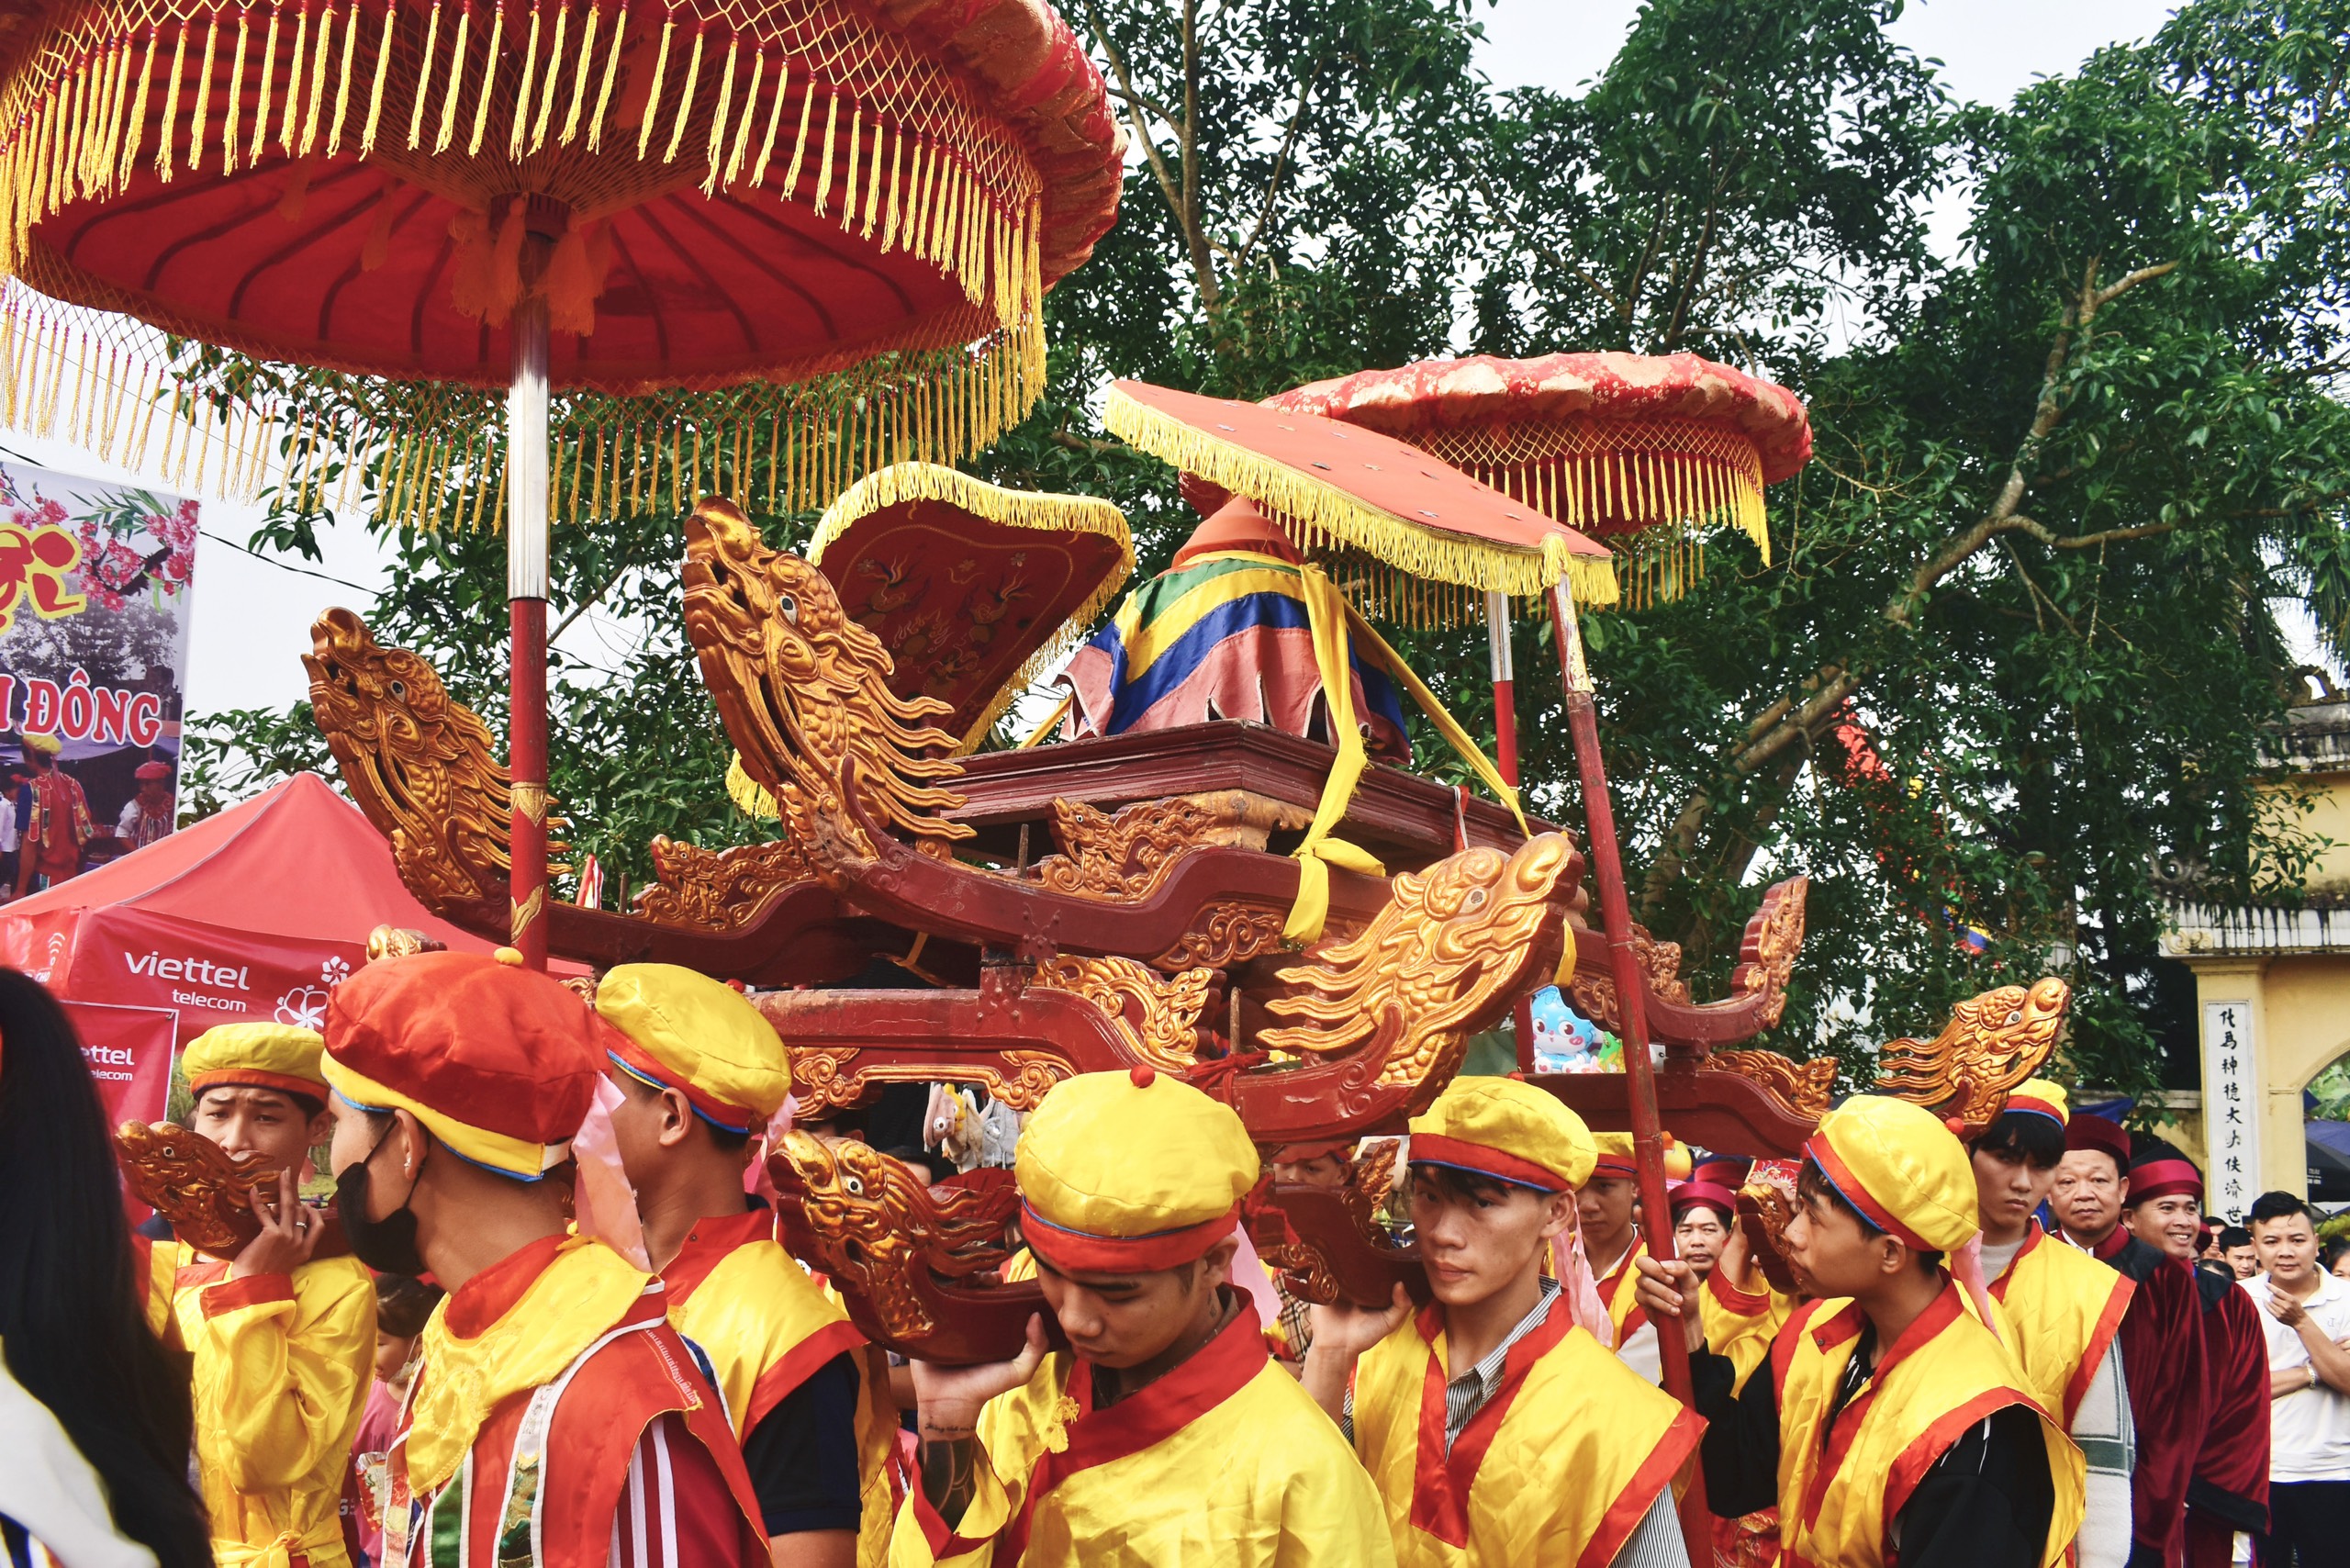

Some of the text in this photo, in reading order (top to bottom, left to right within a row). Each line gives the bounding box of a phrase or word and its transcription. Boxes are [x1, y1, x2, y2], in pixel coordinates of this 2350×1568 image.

[22, 667, 162, 748] ĐÔNG
[124, 950, 251, 991] viettel
[172, 988, 247, 1013] telecom
